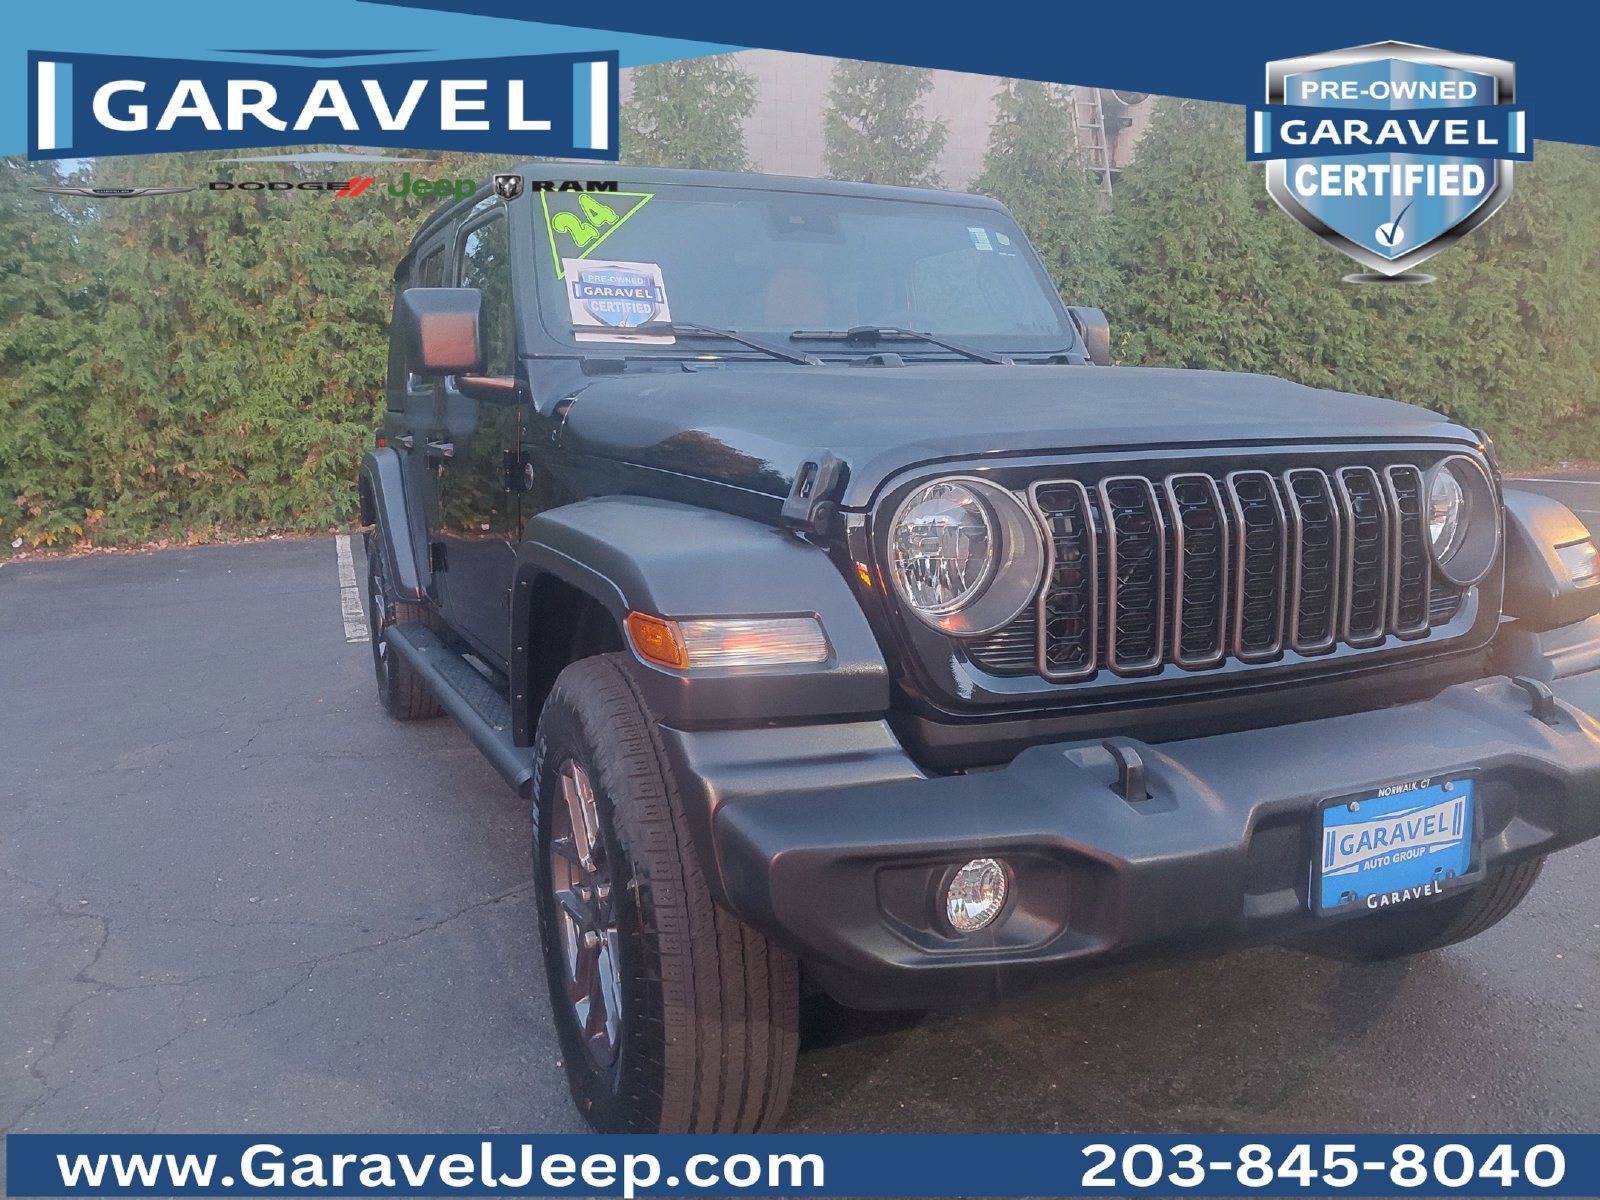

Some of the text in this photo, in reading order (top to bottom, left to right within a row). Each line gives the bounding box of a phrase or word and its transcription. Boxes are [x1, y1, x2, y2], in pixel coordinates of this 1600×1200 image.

[551, 193, 620, 248] 24
[588, 274, 645, 286] PRE-OWNED
[583, 286, 653, 299] GARAVEL
[590, 300, 652, 315] CERTIFIED
[1339, 812, 1449, 856] GARAVEL
[1363, 847, 1426, 871] AUTO GROUP
[1366, 880, 1443, 909] GARAVEL
